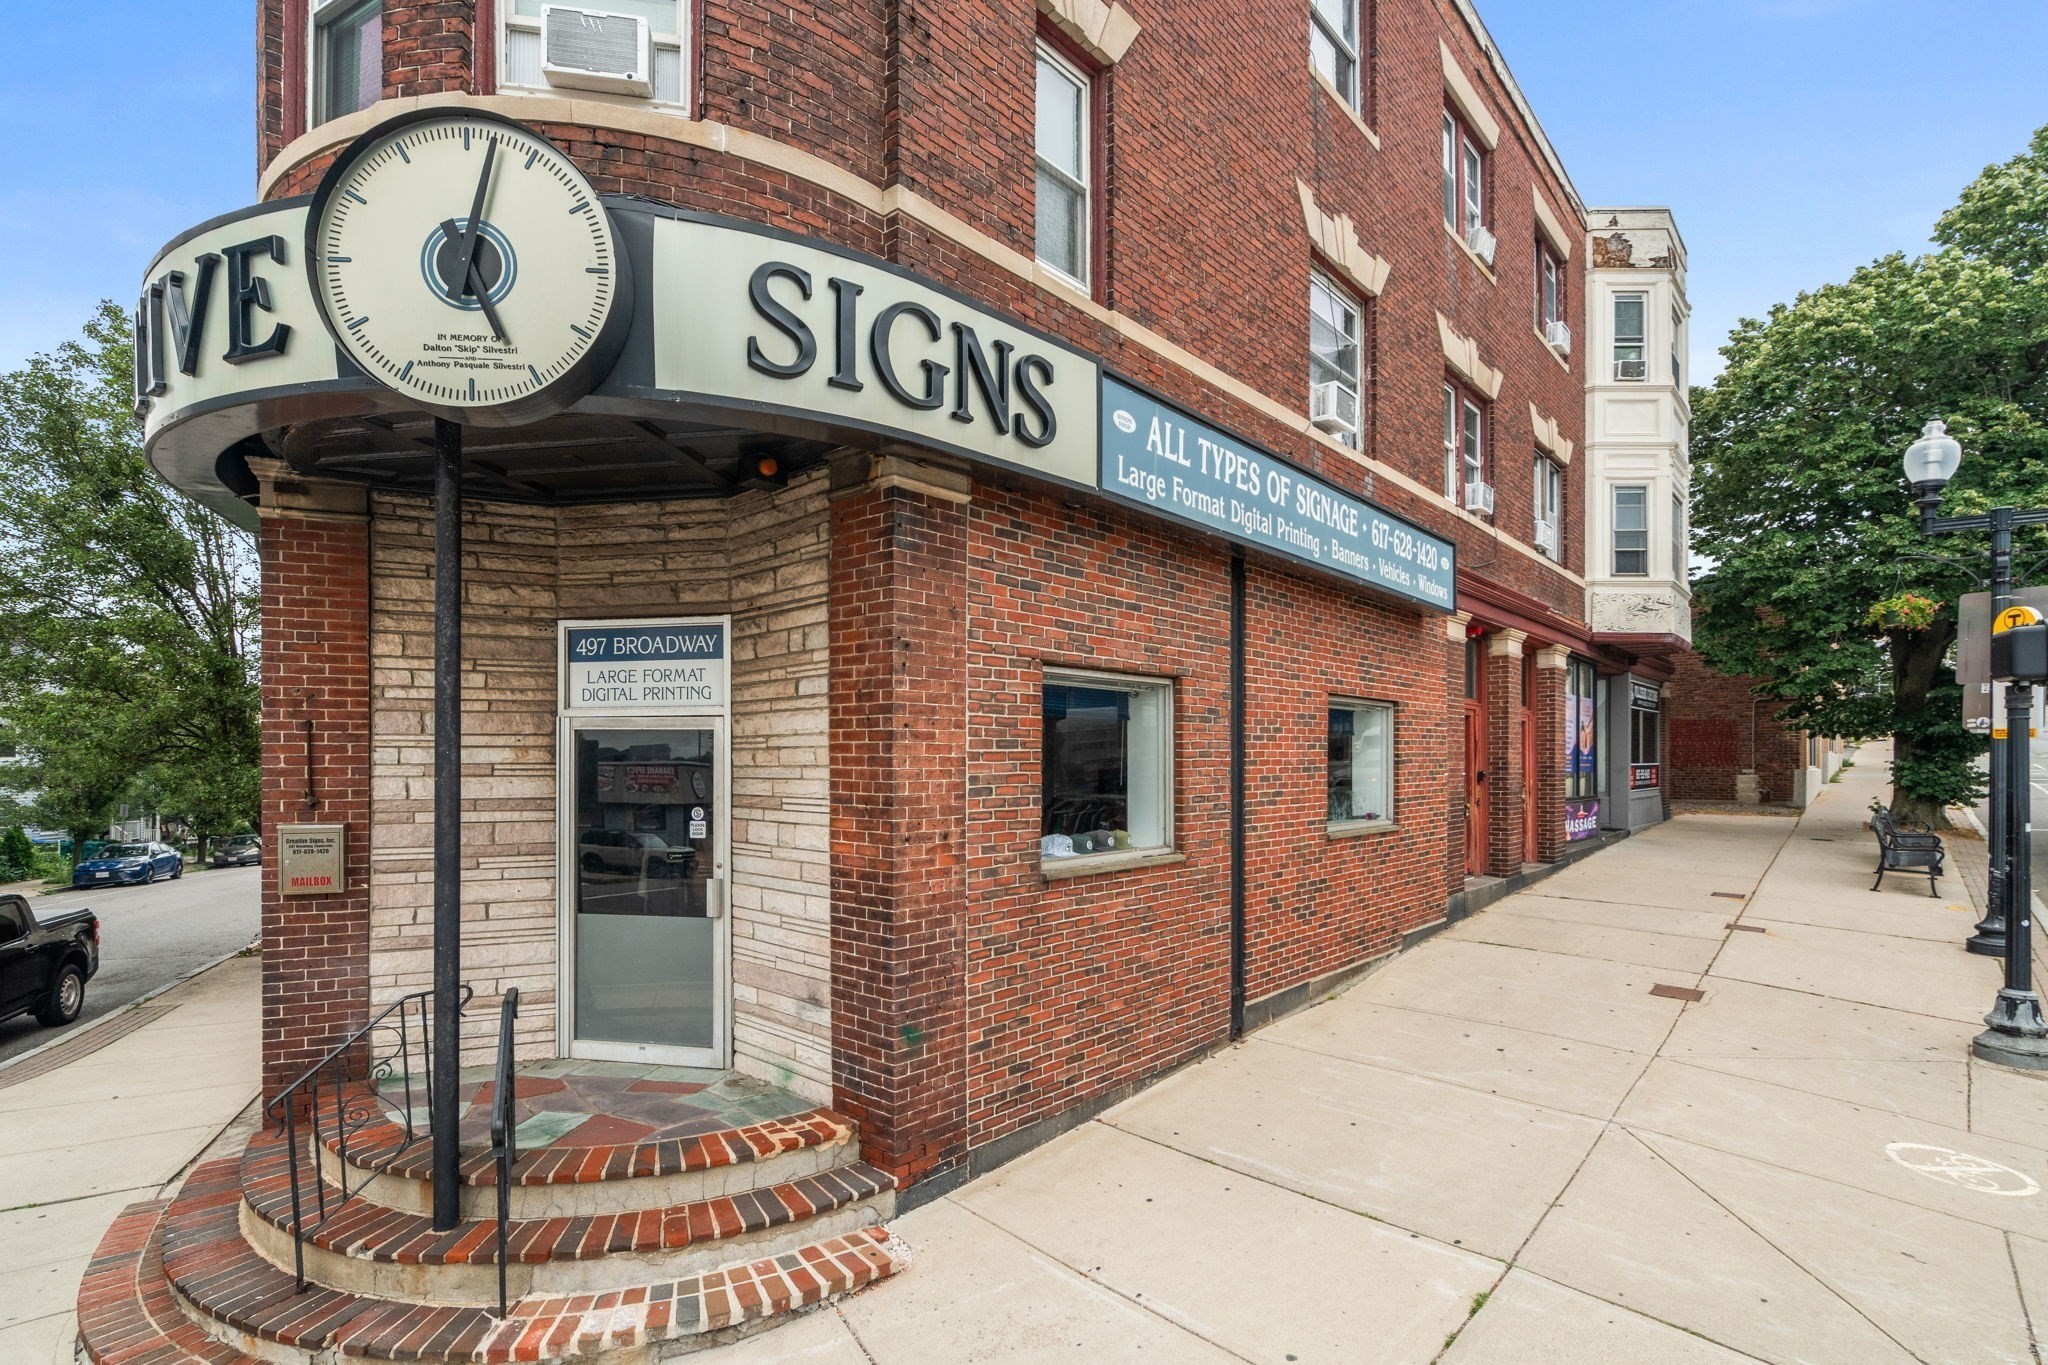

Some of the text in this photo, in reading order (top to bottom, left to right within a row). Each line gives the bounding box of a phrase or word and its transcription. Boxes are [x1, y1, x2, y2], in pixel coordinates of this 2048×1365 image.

[437, 333, 447, 341] IN
[450, 334, 488, 342] MEMORY
[423, 343, 518, 354] Dalton "Skip" Silvestri
[747, 260, 1057, 449] SIGNS
[416, 360, 525, 370] Anthony Pasquale Silvestri
[1146, 416, 1438, 571] ALL TYPES OF SIGNAGE 617-628-1420
[1117, 454, 1448, 600] Large Format Digital Printing Banners Vehicles Windows
[2008, 614, 2021, 626] T
[575, 635, 717, 656] 497 BROADWAY
[587, 668, 706, 684] LARGE FORMAT
[582, 685, 712, 702] DIGITAL PRINTING
[291, 877, 331, 887] MAILBOX
